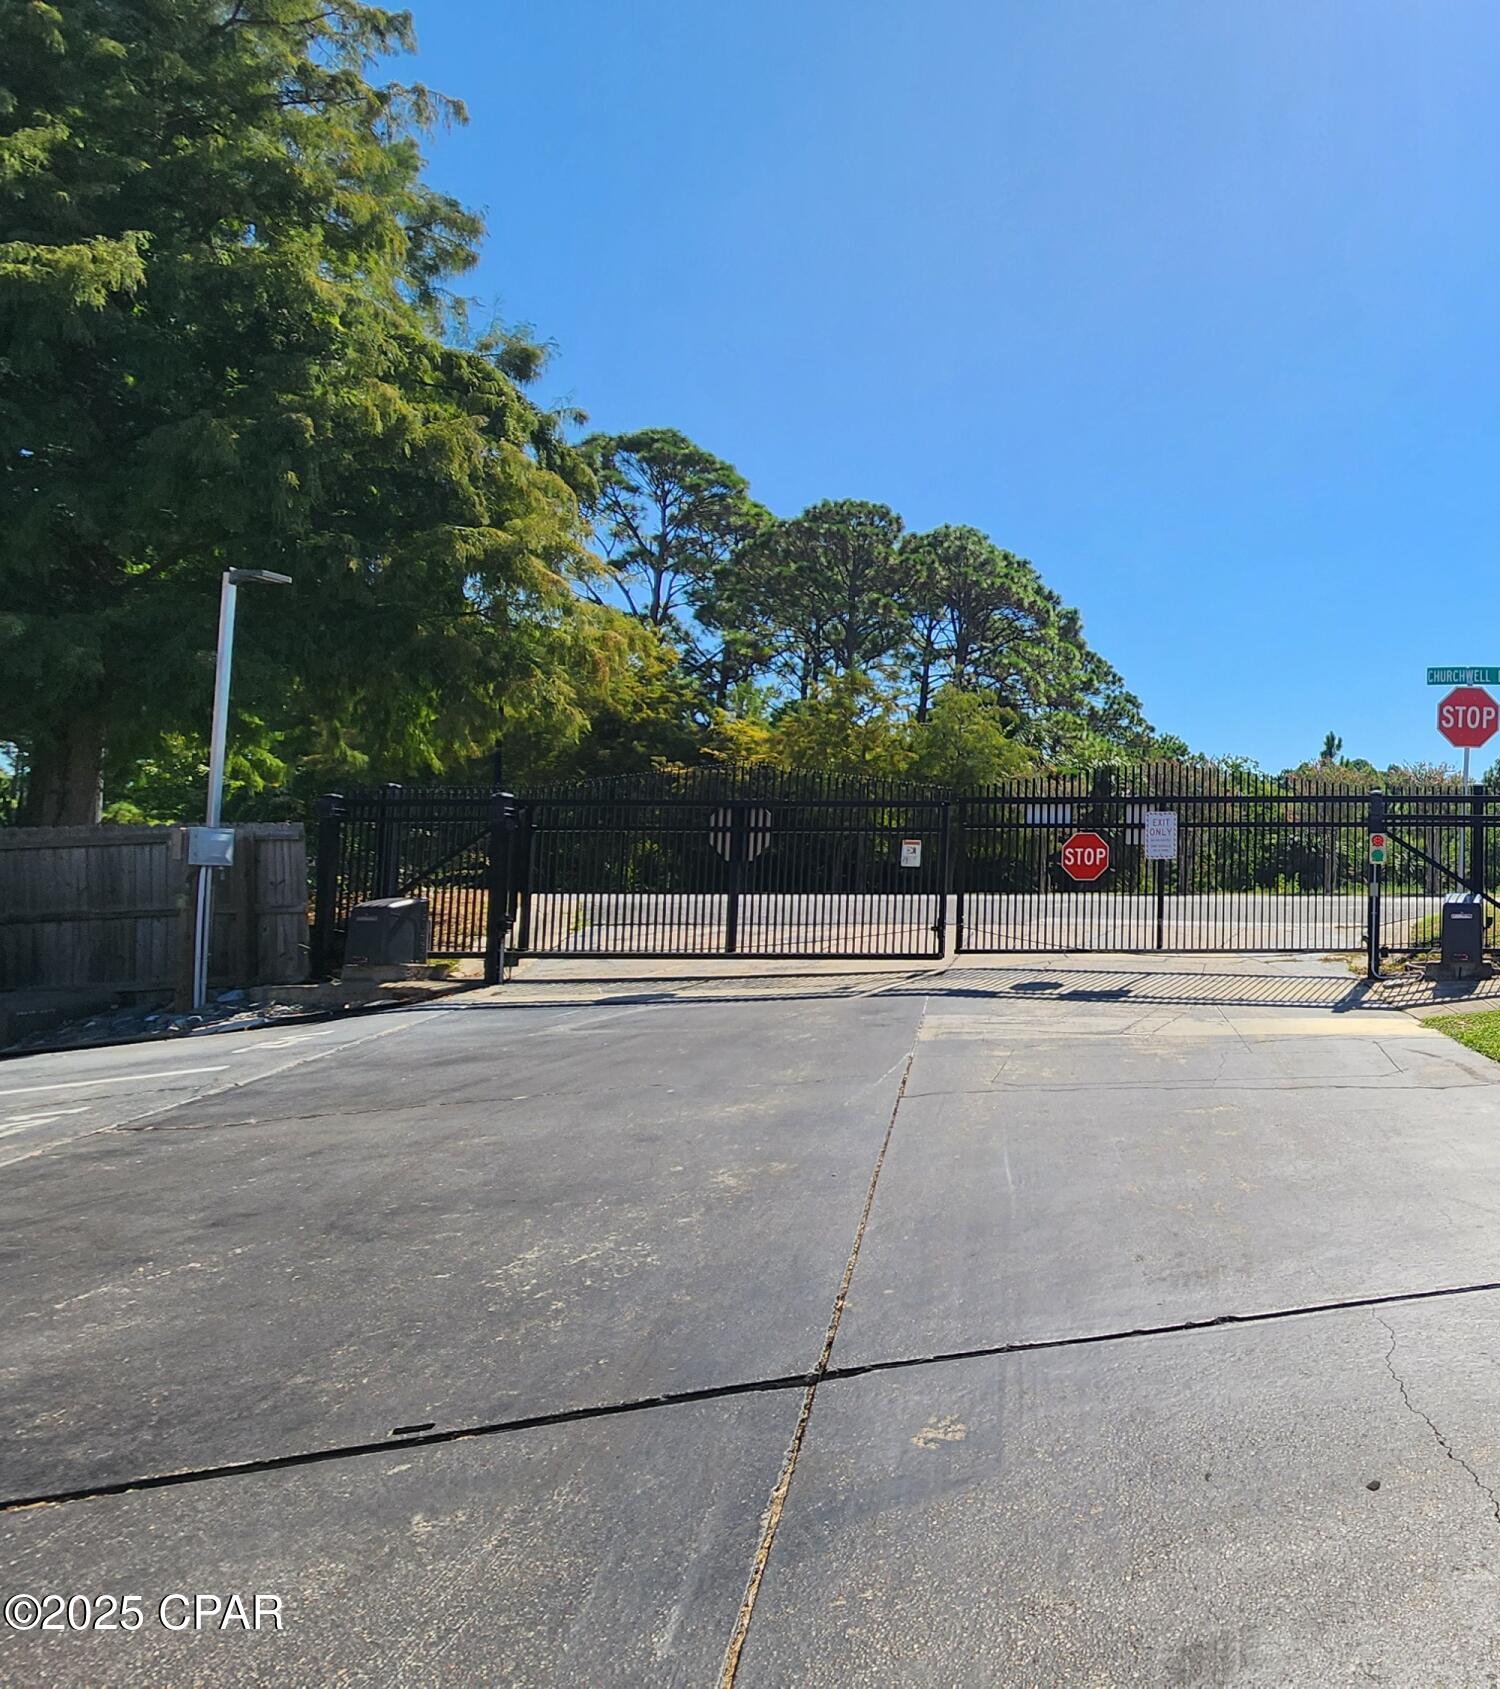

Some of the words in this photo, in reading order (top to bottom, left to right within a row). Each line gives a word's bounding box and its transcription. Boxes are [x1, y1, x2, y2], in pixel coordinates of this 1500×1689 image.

[1427, 670, 1491, 683] CHURCHWELL
[1441, 705, 1496, 729] STOP
[1152, 818, 1169, 827] EXIT
[1150, 828, 1172, 837] ONLY
[1064, 848, 1106, 866] STOP
